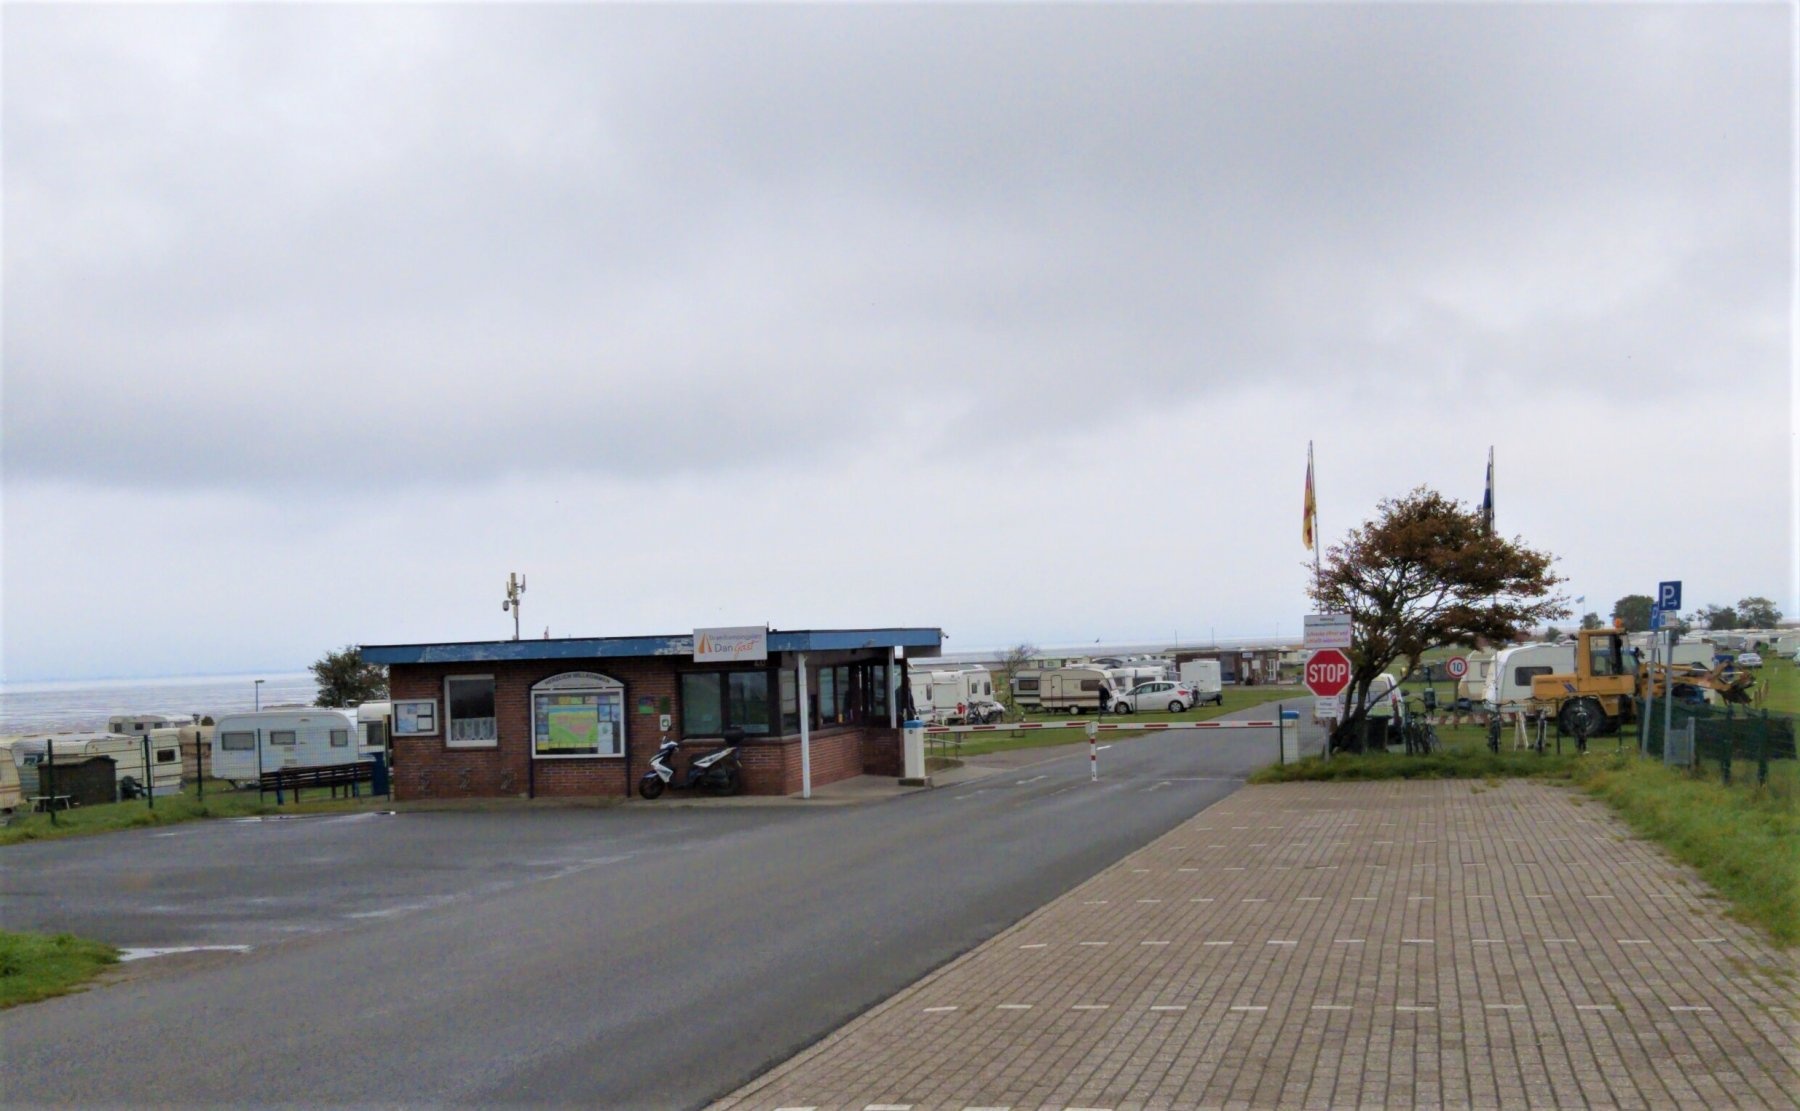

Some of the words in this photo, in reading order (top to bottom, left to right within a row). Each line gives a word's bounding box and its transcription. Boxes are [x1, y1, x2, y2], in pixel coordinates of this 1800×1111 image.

[1662, 585, 1675, 608] P
[1309, 663, 1347, 683] STOP
[1452, 662, 1462, 672] 10
